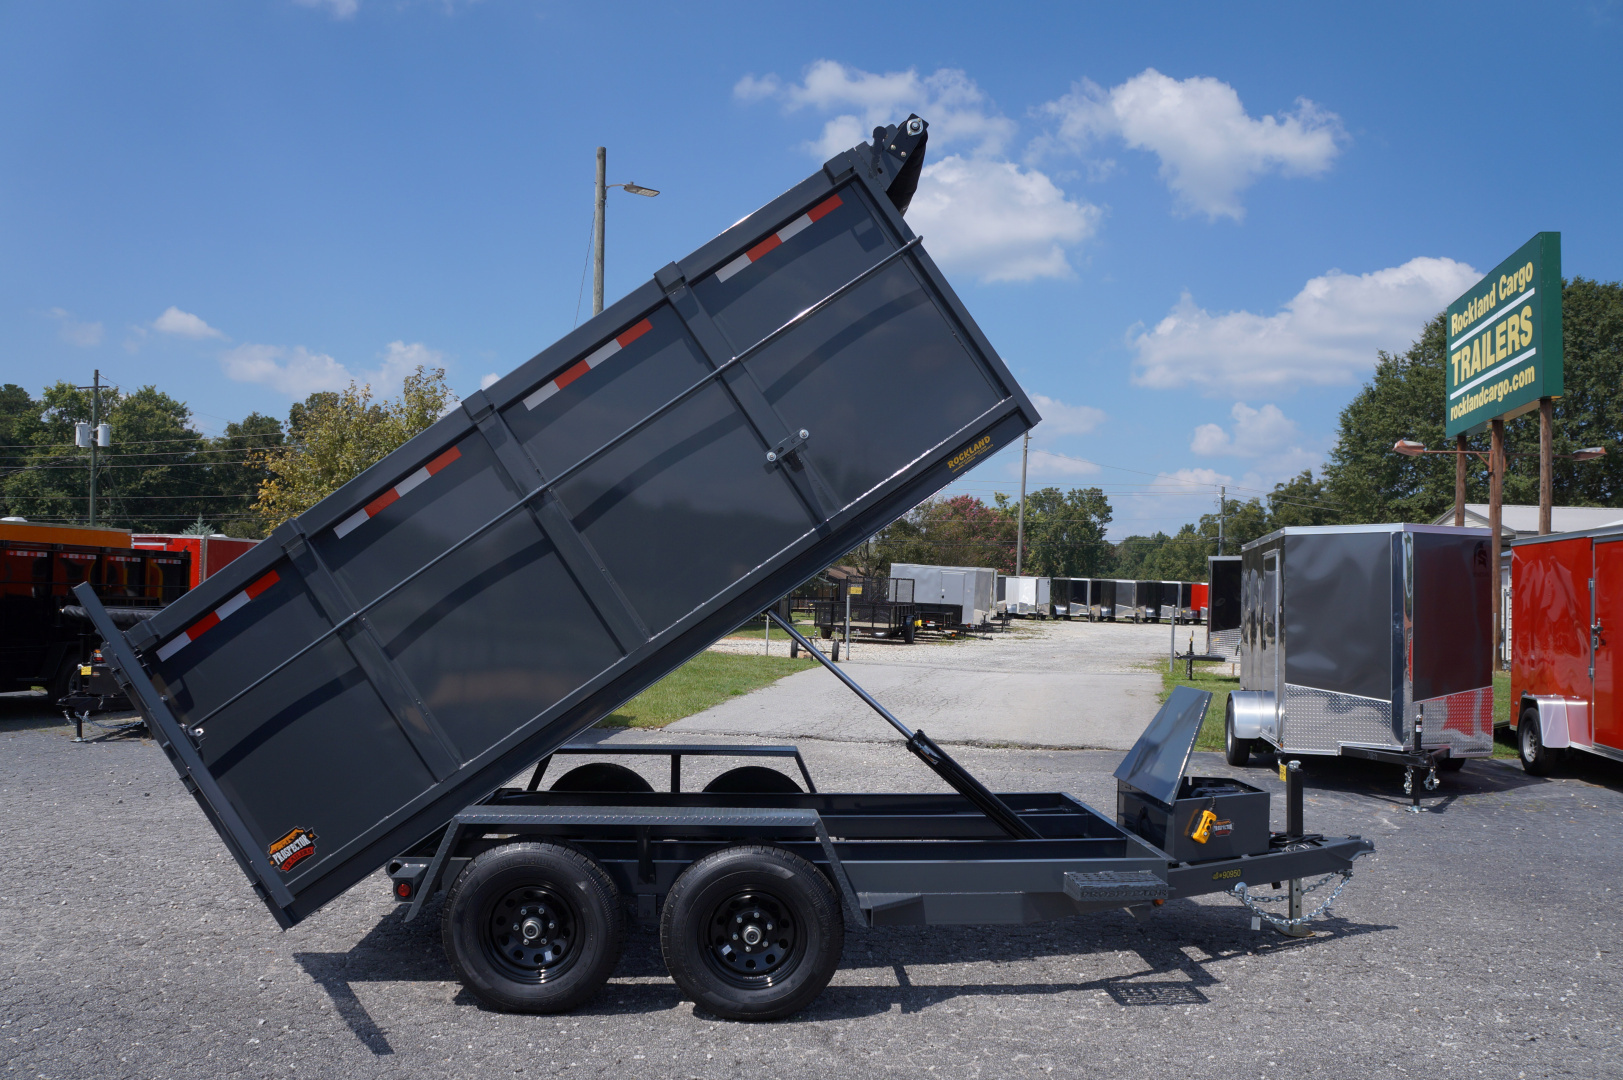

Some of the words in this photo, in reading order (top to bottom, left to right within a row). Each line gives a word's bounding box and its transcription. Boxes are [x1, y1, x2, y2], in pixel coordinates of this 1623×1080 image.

[1451, 282, 1496, 337] Rockland
[1498, 261, 1534, 301] Cargo
[1451, 305, 1533, 386] TRAILERS
[1450, 365, 1536, 421] rocklandcargo.com
[947, 435, 991, 469] ROCKLAND
[272, 834, 311, 865] PROSPECTOR
[284, 847, 312, 869] TRAILERS
